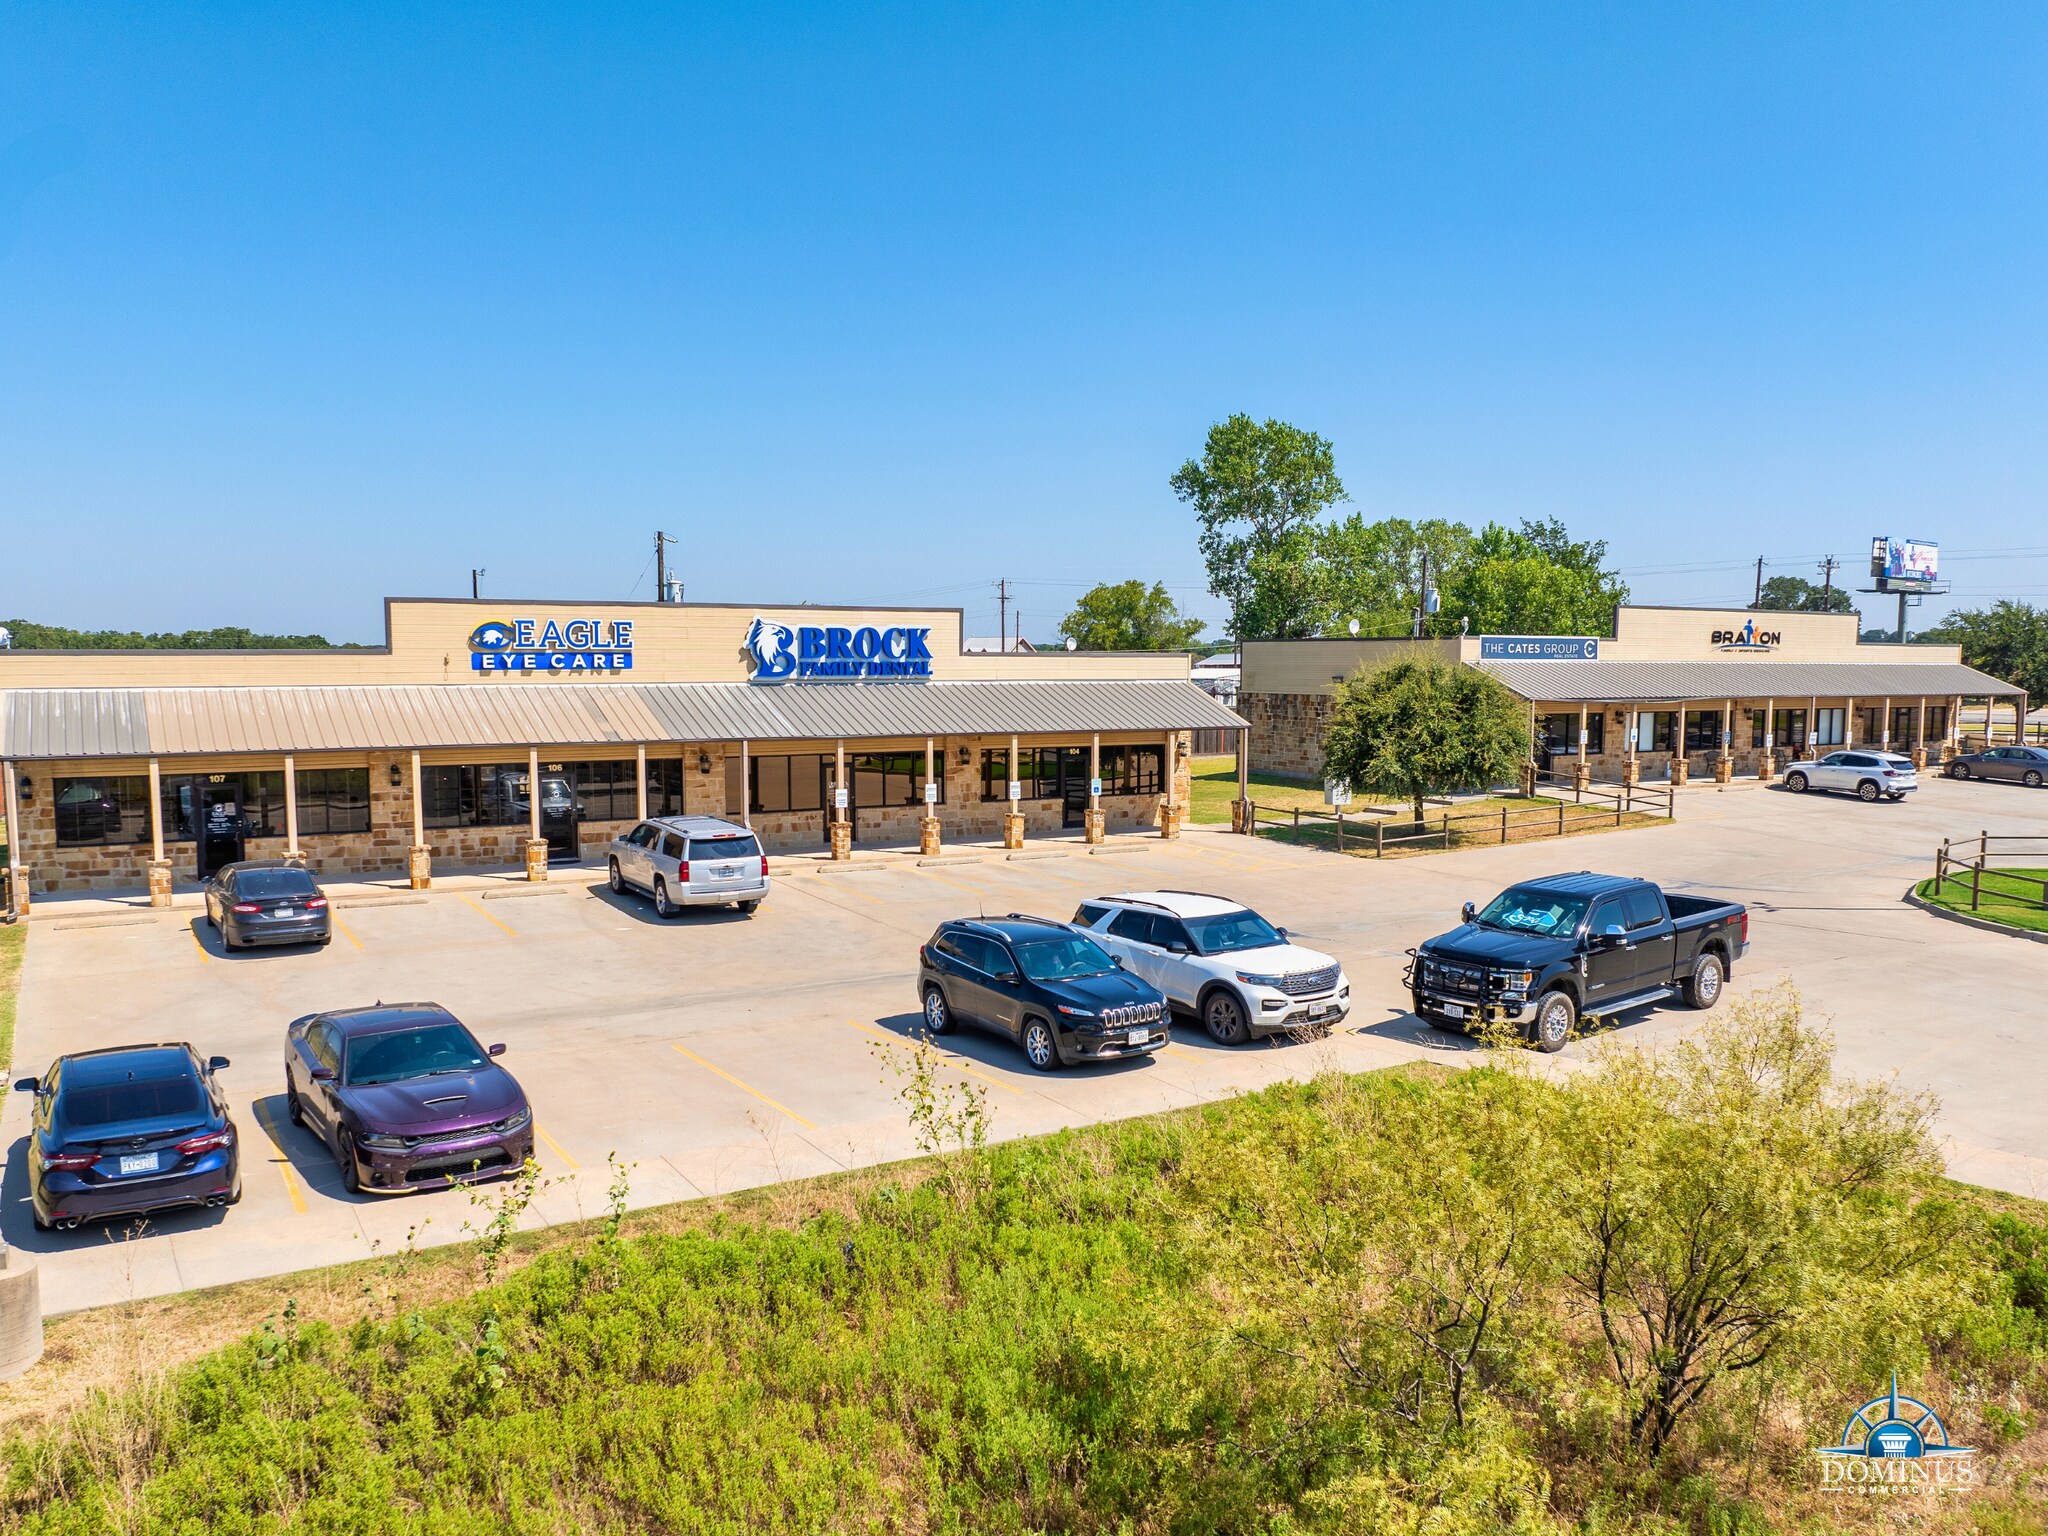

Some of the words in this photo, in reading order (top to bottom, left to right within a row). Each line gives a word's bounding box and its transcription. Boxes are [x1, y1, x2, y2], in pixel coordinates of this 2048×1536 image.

[513, 619, 633, 650] EAGLE
[799, 627, 934, 660] BROCK
[1484, 643, 1504, 653] THE
[1508, 643, 1540, 653] CATES
[1543, 643, 1579, 653] GROUP
[482, 654, 537, 668] EYE
[550, 654, 625, 668] CARE
[799, 661, 867, 676] FAMILY
[868, 661, 934, 676] DENTAL
[208, 775, 226, 783] 107
